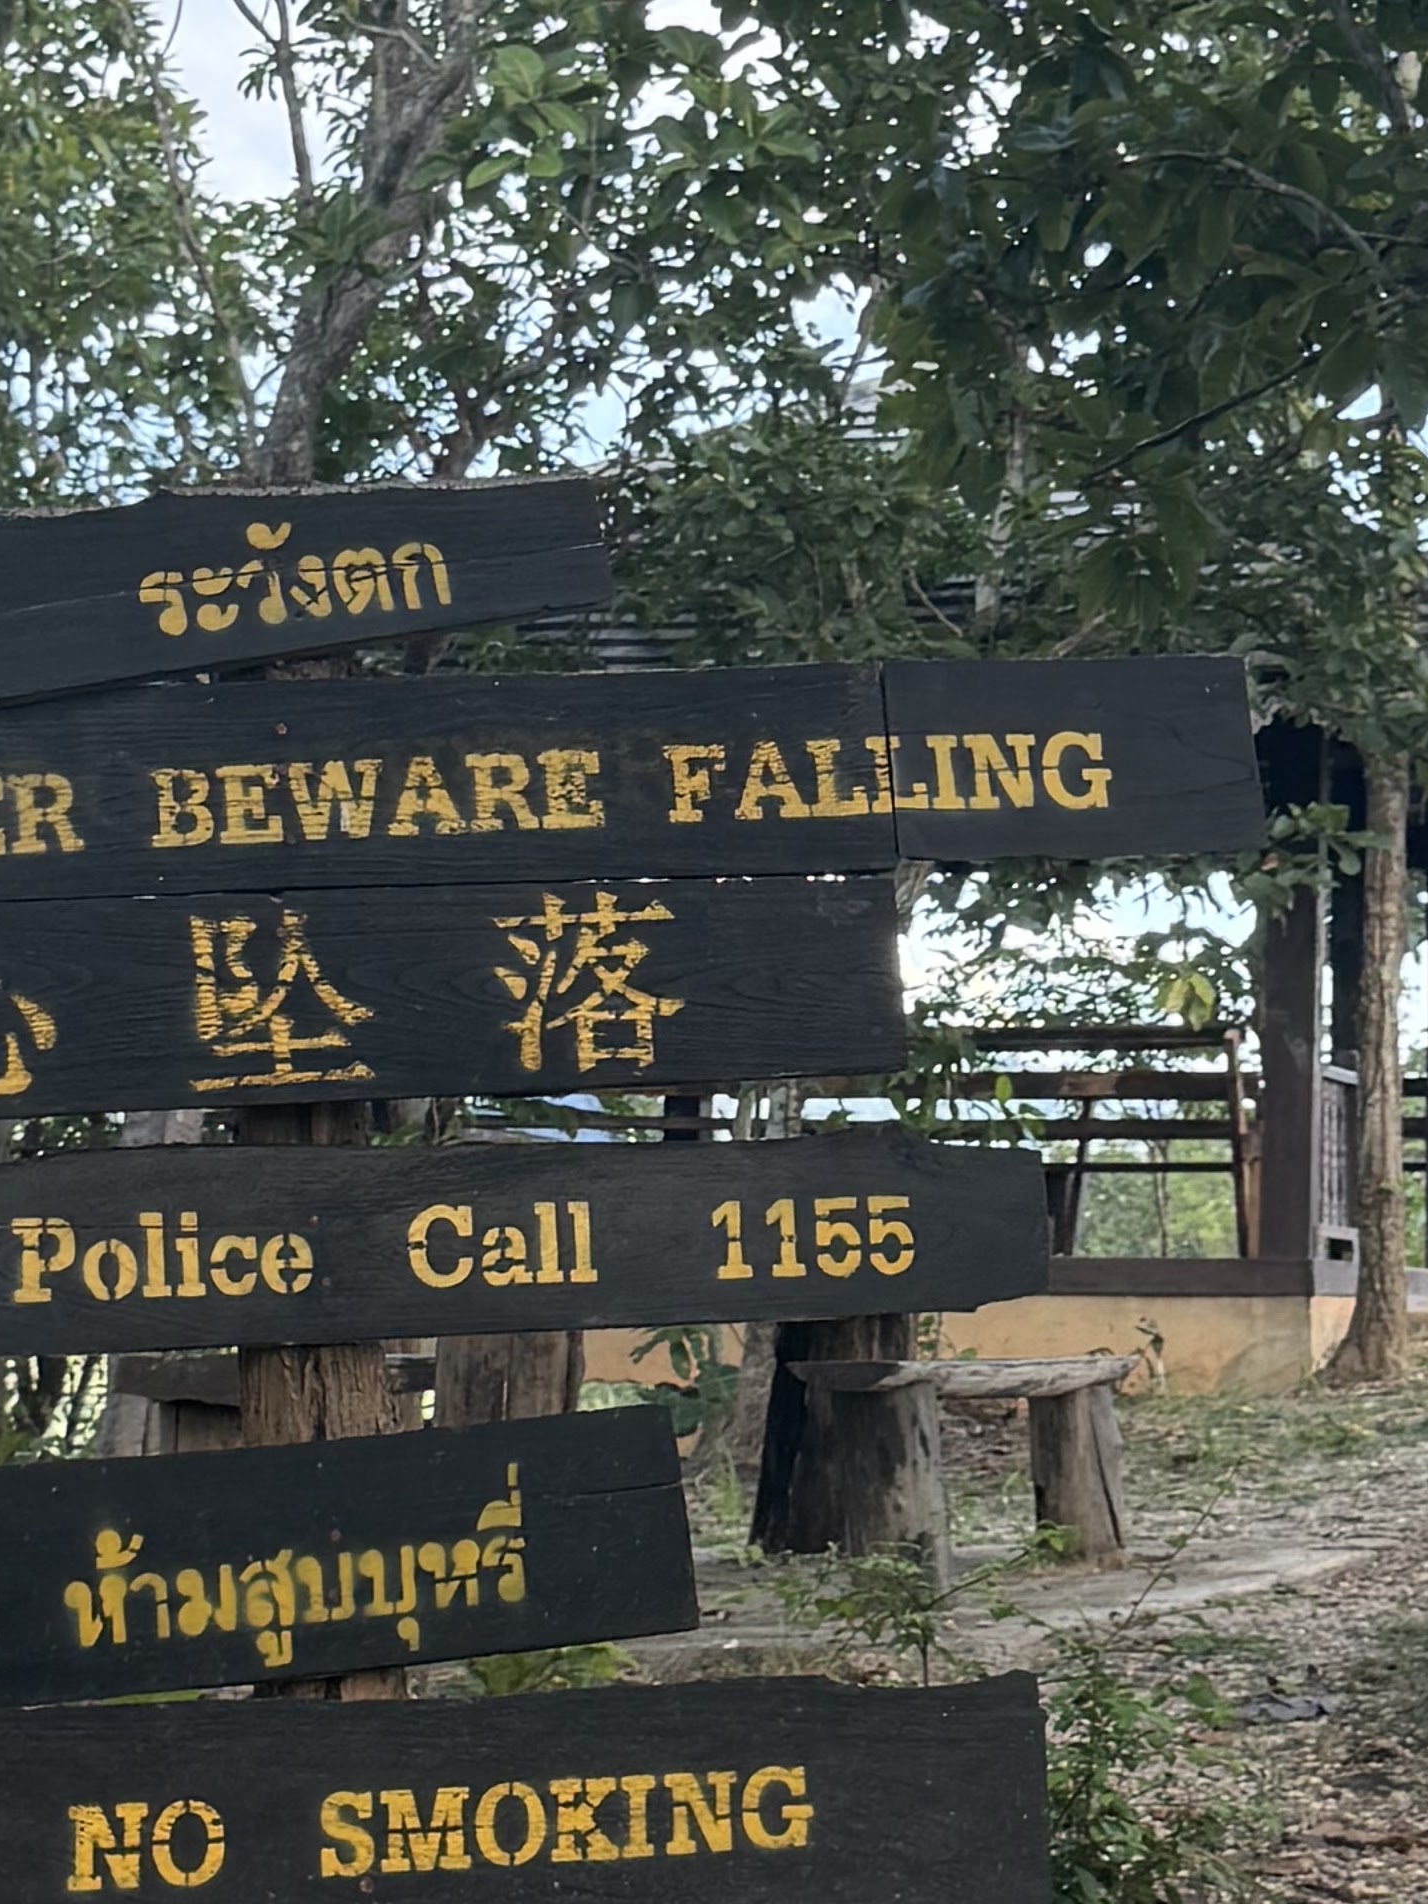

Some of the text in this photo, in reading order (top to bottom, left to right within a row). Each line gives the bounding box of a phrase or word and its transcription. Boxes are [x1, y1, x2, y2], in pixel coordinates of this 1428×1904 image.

[138, 524, 449, 637] ระวังตก
[151, 749, 604, 848] BEWARE
[666, 731, 1110, 824] FALLING
[10, 1211, 311, 1304] Police
[406, 1203, 596, 1289] Call
[711, 1195, 914, 1280] 1155
[63, 1462, 526, 1668] ห้ามสูบบุหรี่
[66, 1765, 815, 1893] NO SMOKING
